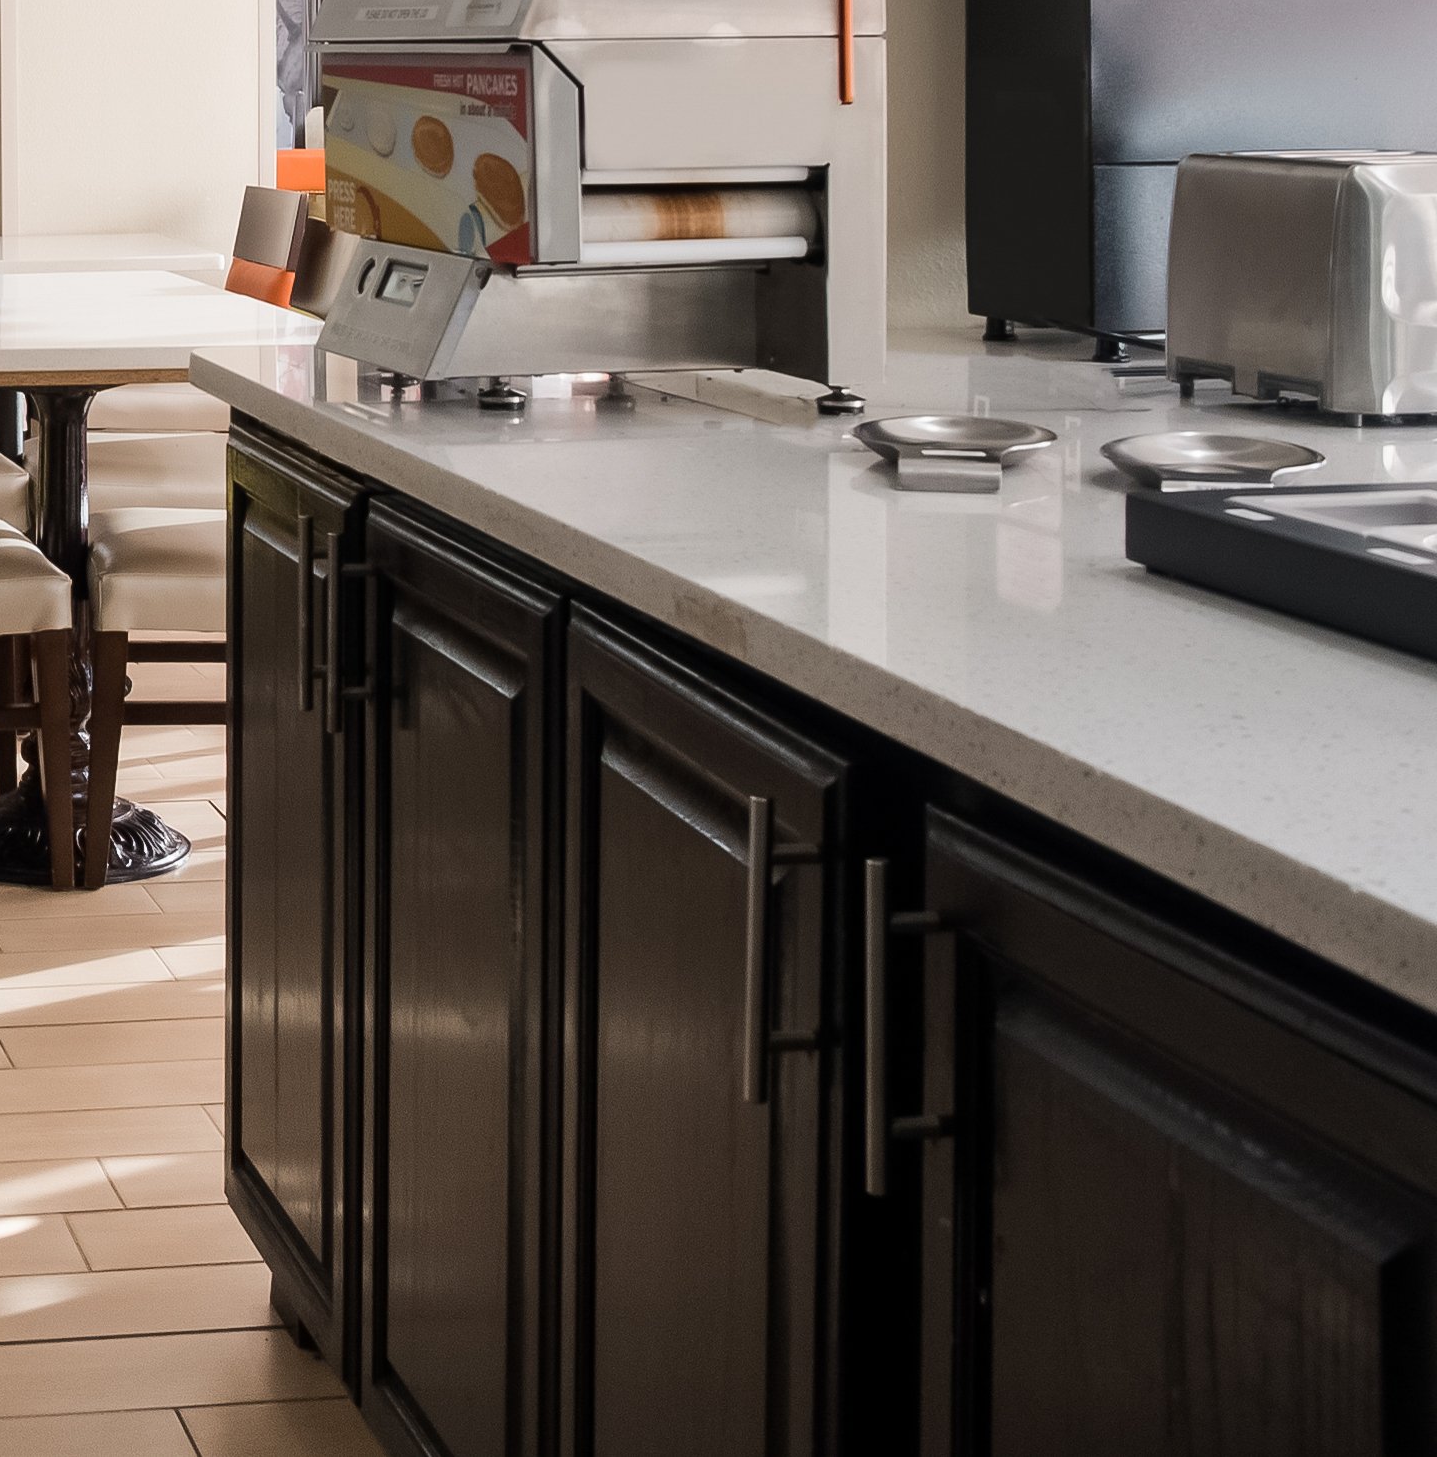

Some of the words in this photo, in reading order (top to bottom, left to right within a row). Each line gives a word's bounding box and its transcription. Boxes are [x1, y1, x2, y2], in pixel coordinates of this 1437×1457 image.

[466, 73, 518, 96] PANCAKES
[327, 179, 356, 203] PRESS
[334, 204, 356, 229] HERE
